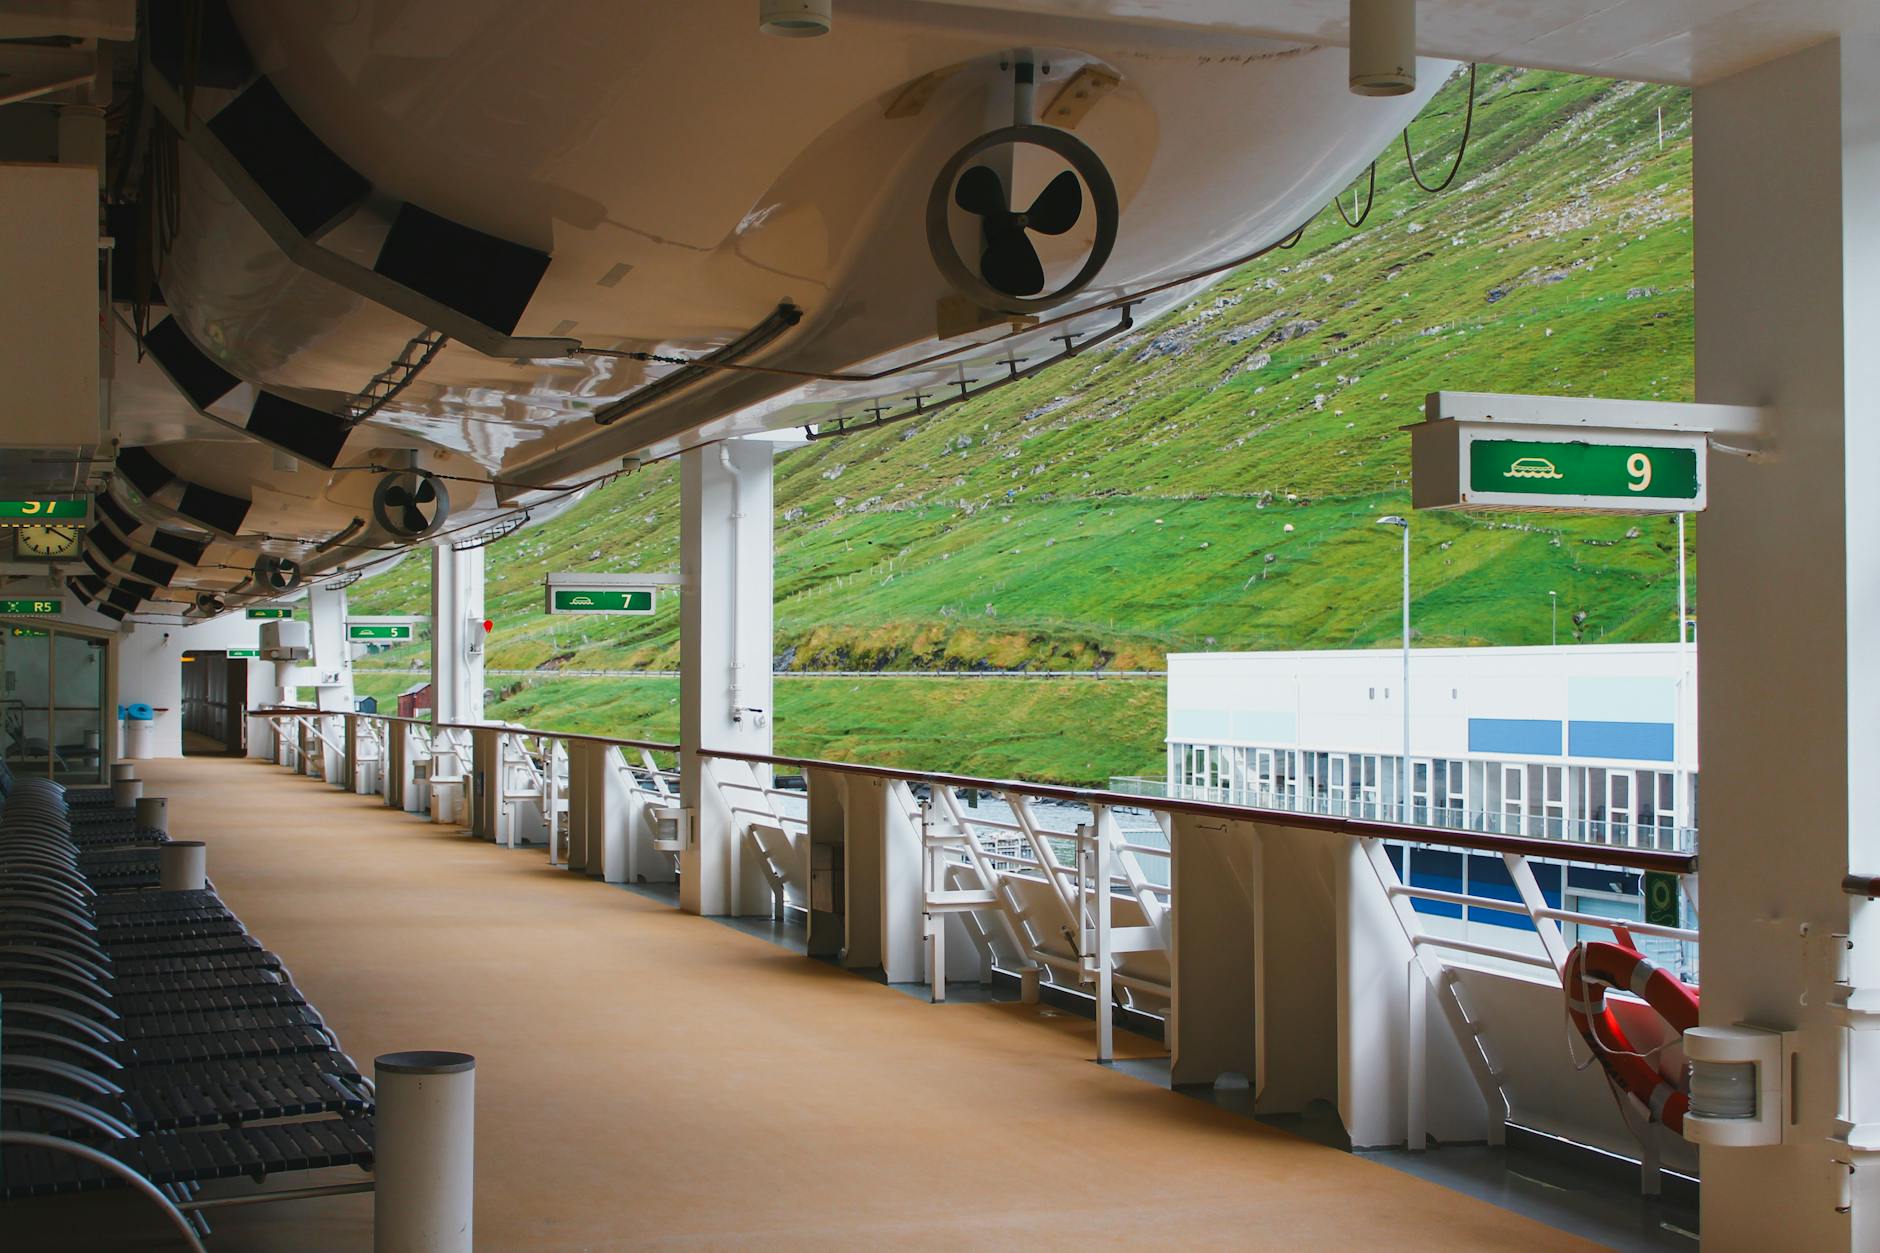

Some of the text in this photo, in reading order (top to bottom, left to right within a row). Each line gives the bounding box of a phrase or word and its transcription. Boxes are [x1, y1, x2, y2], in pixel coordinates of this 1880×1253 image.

[1626, 453, 1652, 492] 9
[621, 594, 632, 609] 7
[34, 602, 52, 612] R5
[277, 609, 283, 618] 3
[390, 627, 398, 637] 5
